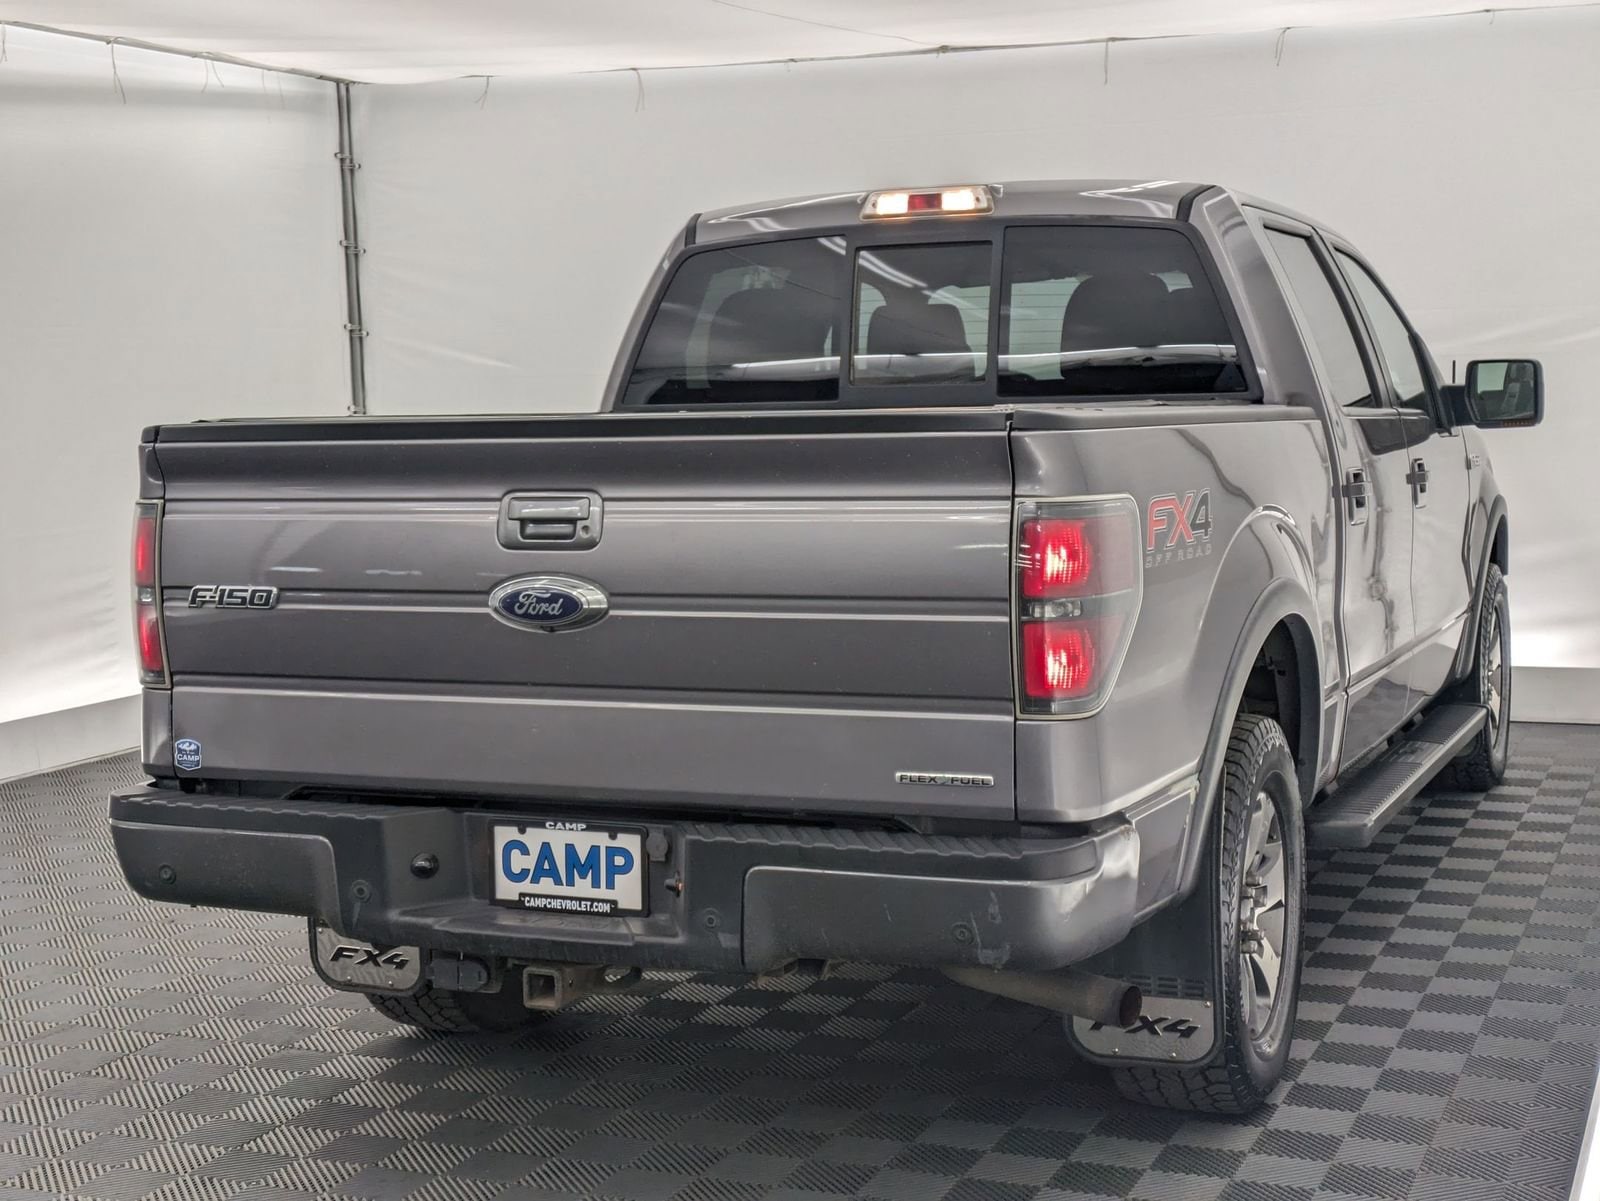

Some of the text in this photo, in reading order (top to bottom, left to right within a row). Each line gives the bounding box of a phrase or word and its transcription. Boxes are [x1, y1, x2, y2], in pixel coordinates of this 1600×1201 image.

[1146, 487, 1213, 553] FX4
[514, 590, 563, 615] Ford
[899, 774, 990, 786] FLEX FUEL
[545, 821, 587, 831] CAMP
[502, 839, 634, 890] CAMP
[524, 896, 611, 913] CAMPCHEVROLET.COM
[329, 945, 410, 970] FX4
[1089, 1015, 1201, 1038] X4
